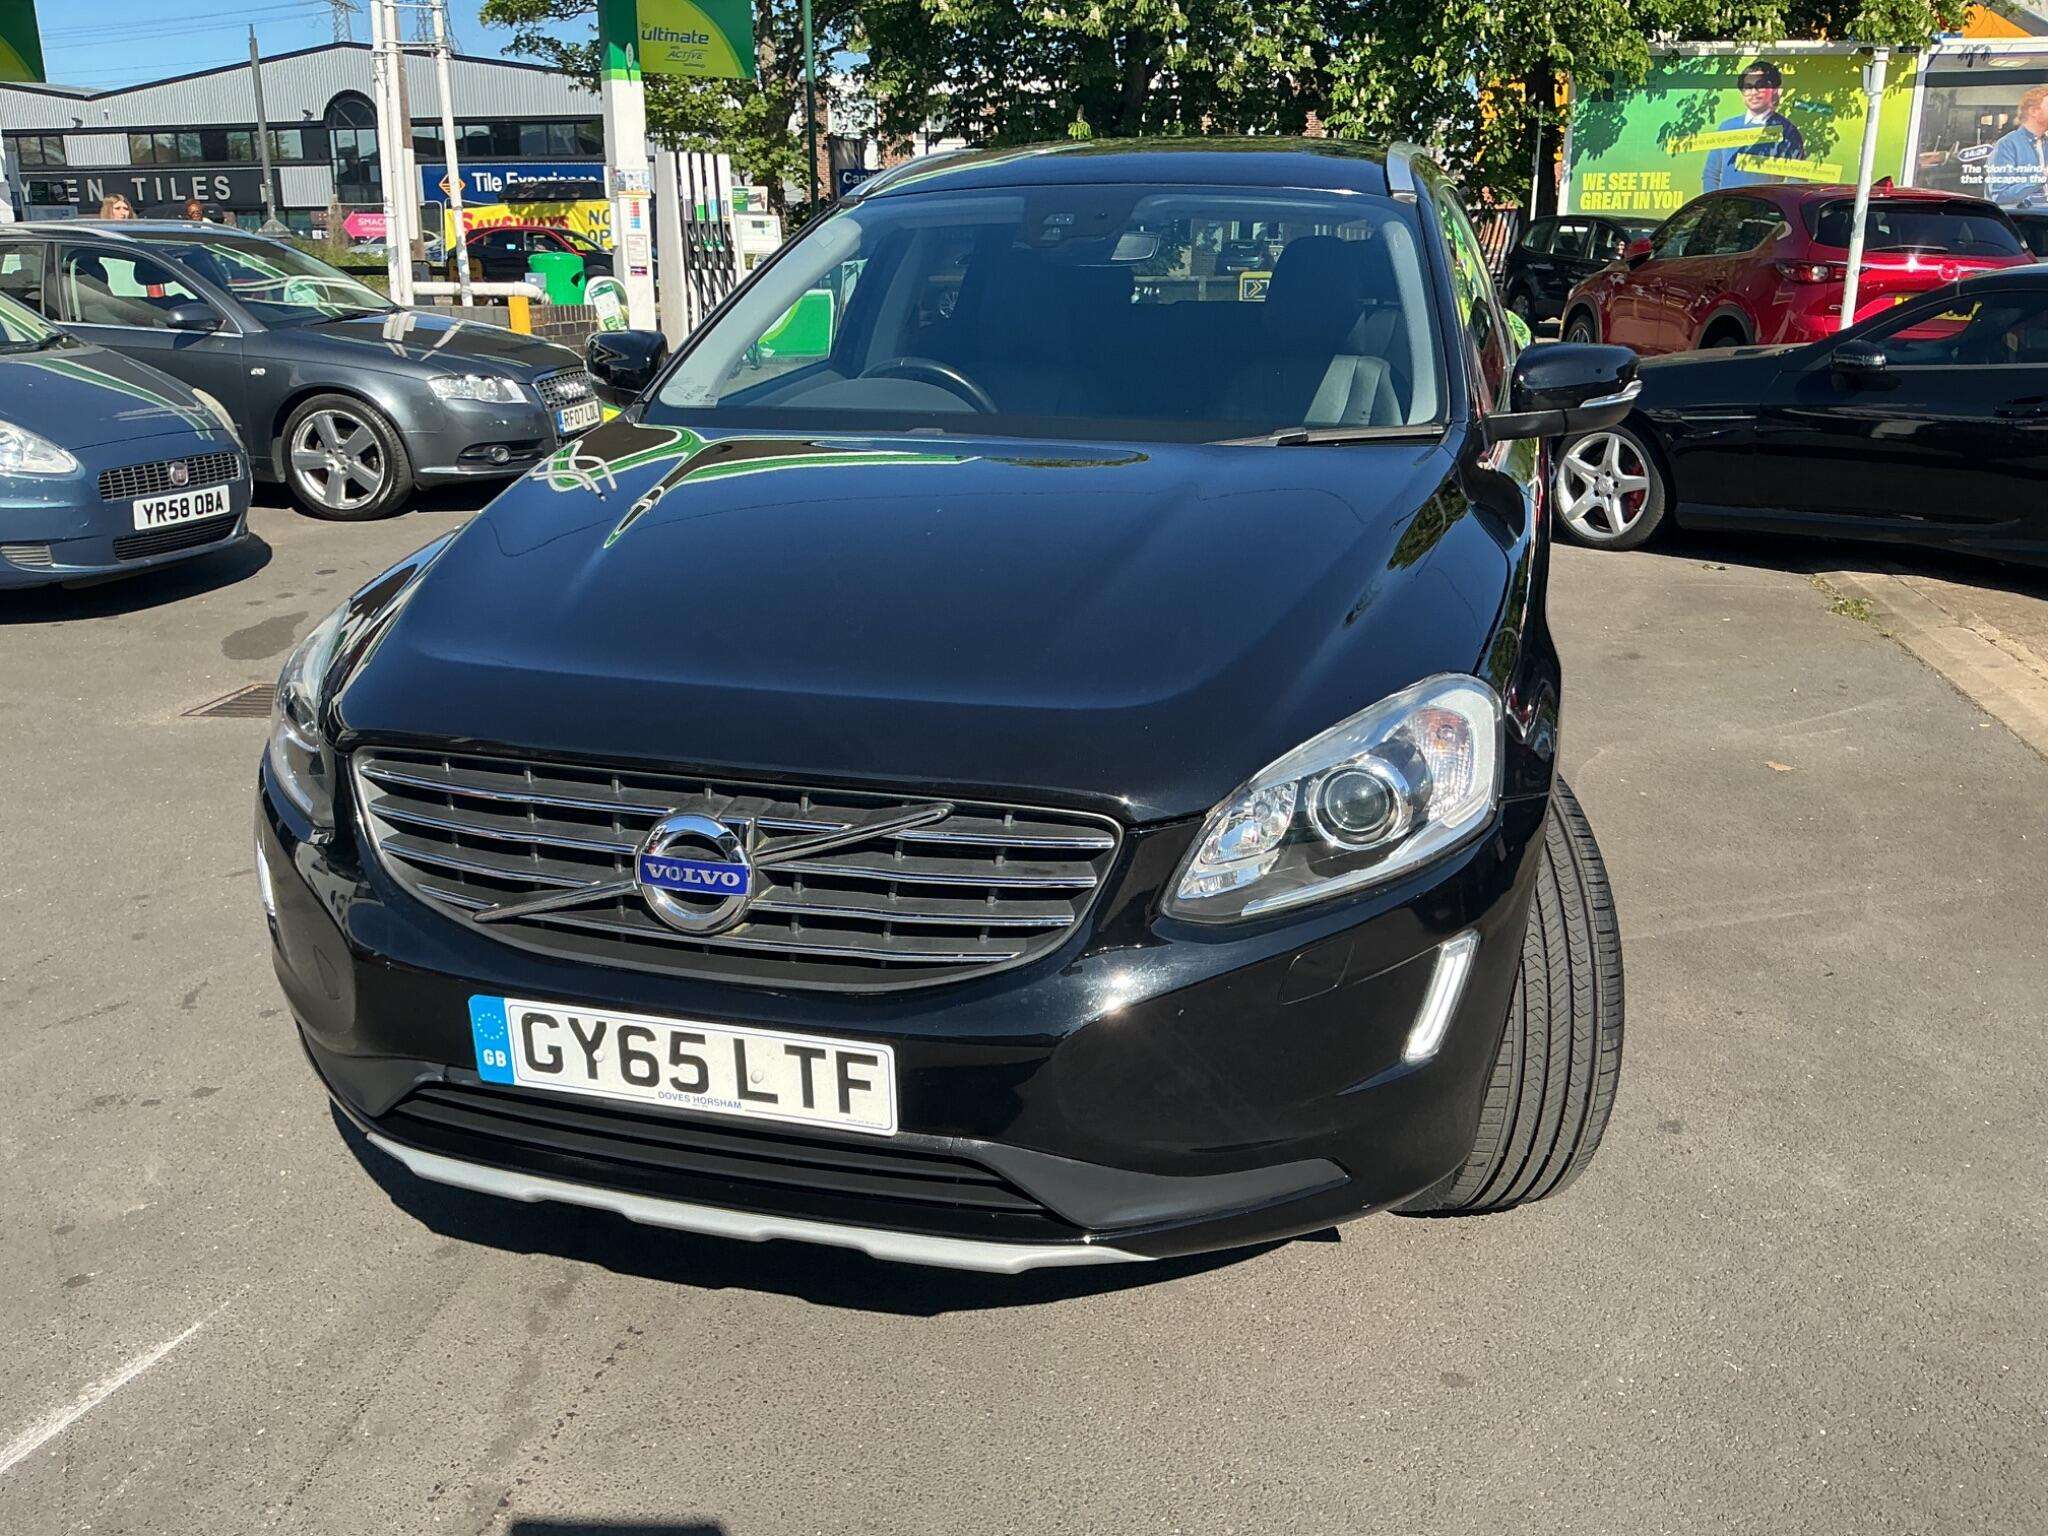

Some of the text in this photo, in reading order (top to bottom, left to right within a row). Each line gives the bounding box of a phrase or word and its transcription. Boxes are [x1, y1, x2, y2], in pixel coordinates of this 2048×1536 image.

[641, 26, 709, 45] ultimate
[1961, 164, 1982, 173] The
[131, 175, 231, 202] TILES
[471, 172, 503, 193] Tile
[1582, 171, 1671, 191] WE SEE THE
[1960, 174, 1983, 184] that
[1984, 175, 2027, 185] escapes
[1580, 190, 1683, 210] GREAT IN YOU
[358, 217, 387, 227] SMAC
[142, 491, 224, 525] YR58 OBA
[644, 862, 741, 887] VOLVO
[483, 1011, 879, 1115] GB GY65 LTF
[658, 1091, 743, 1110] DOVES HORSHAM
